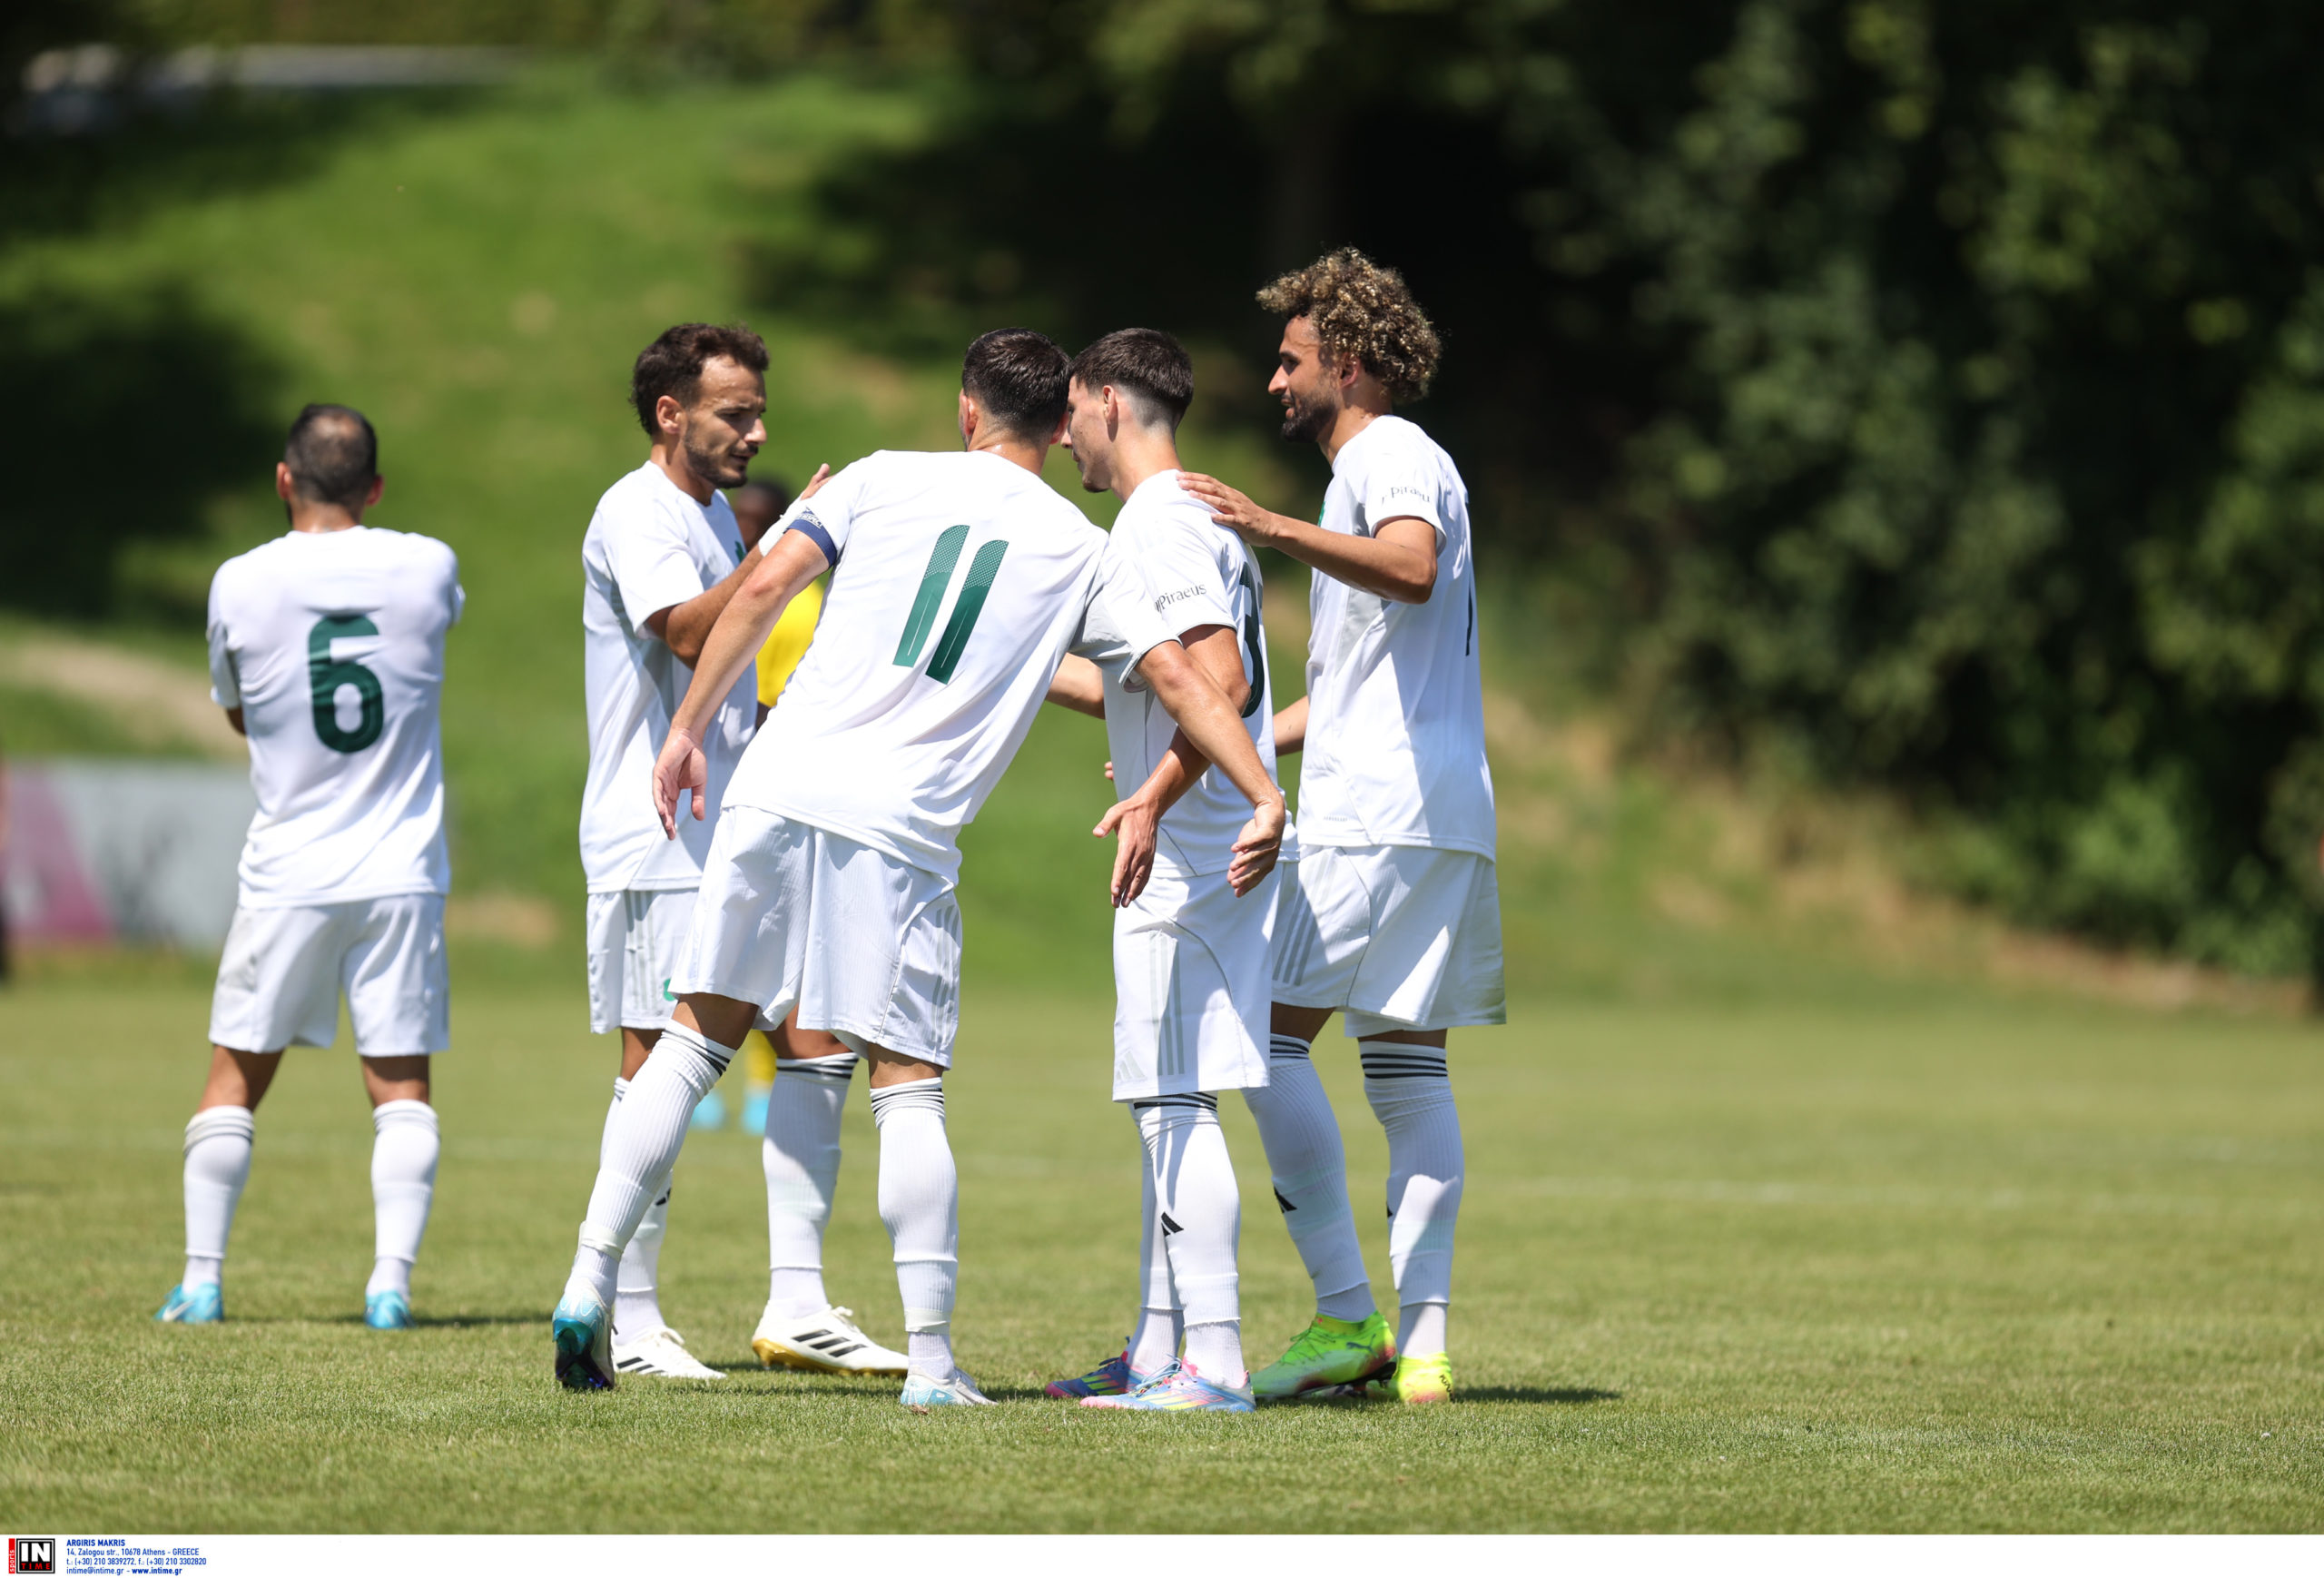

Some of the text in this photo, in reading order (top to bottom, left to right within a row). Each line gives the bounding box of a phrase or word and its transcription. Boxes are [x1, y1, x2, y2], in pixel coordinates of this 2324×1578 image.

[892, 524, 1009, 685] 11
[1157, 584, 1207, 610] Piraeus
[308, 613, 385, 754] 6
